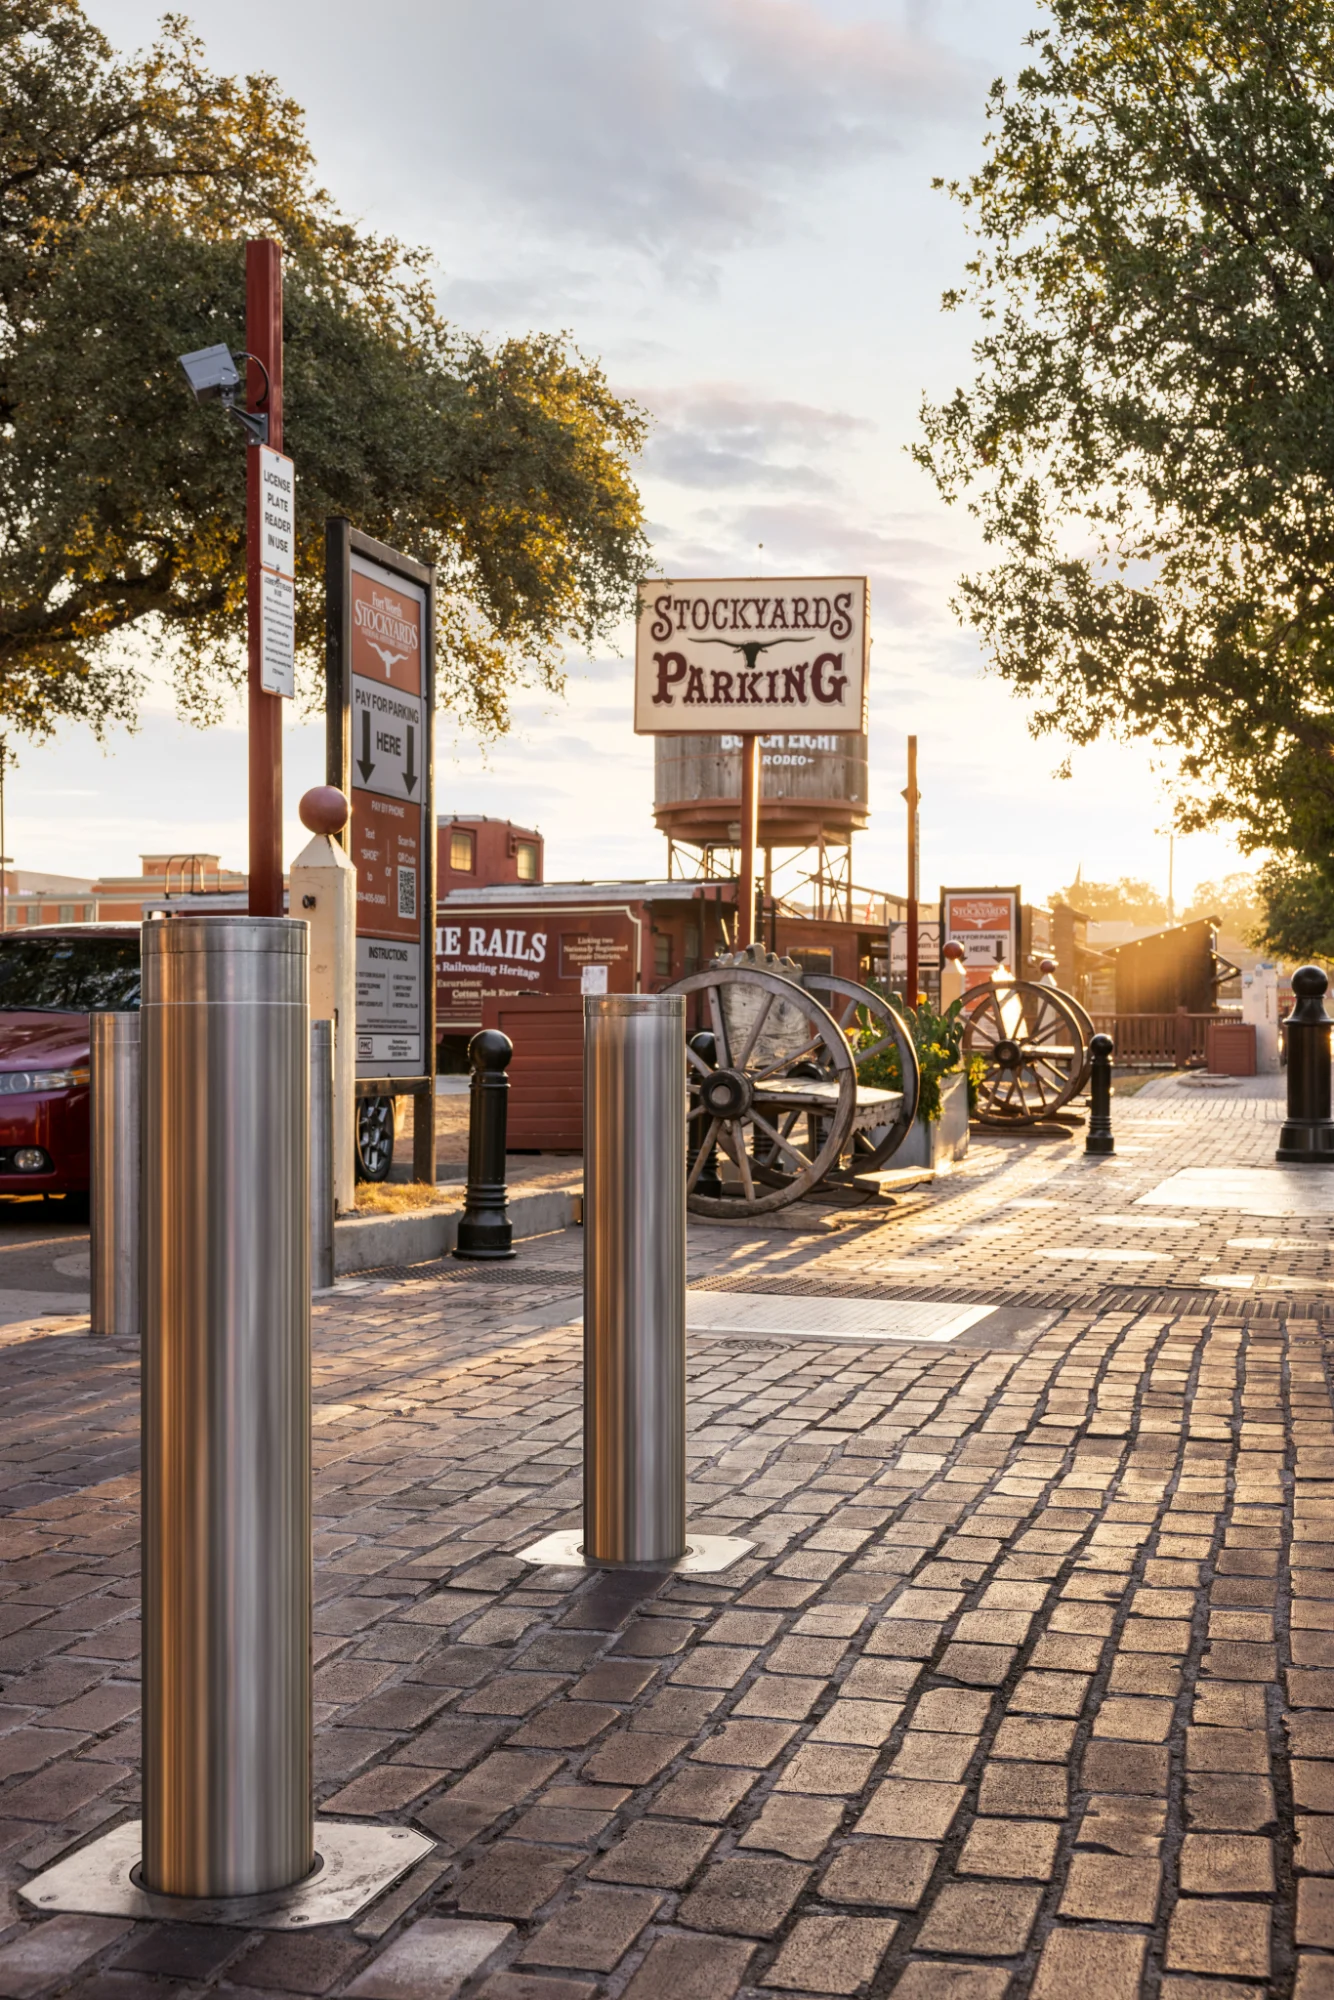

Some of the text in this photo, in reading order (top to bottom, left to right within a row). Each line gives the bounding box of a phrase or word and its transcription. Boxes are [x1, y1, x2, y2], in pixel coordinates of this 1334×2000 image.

[264, 469, 290, 493] LICENSE
[267, 492, 288, 512] PLATE
[265, 512, 292, 534] READER
[268, 534, 288, 553] IN USE
[355, 599, 418, 650] STOCKYARDS
[651, 593, 852, 642] STOCKYARDS
[652, 652, 848, 704] PARKING
[356, 688, 419, 724] PAY FOR PARKING
[376, 730, 401, 756] HERE
[762, 754, 806, 766] RODEO
[372, 800, 404, 818] PAY BY PHONE
[365, 828, 375, 839] Text
[405, 854, 416, 864] Code
[367, 872, 373, 882] to
[385, 866, 392, 876] or
[368, 946, 408, 962] INSTRUCTIONS
[468, 927, 547, 963] RAILS
[442, 962, 497, 976] Railroading
[499, 964, 540, 980] Heritage
[452, 990, 479, 999] Cotton
